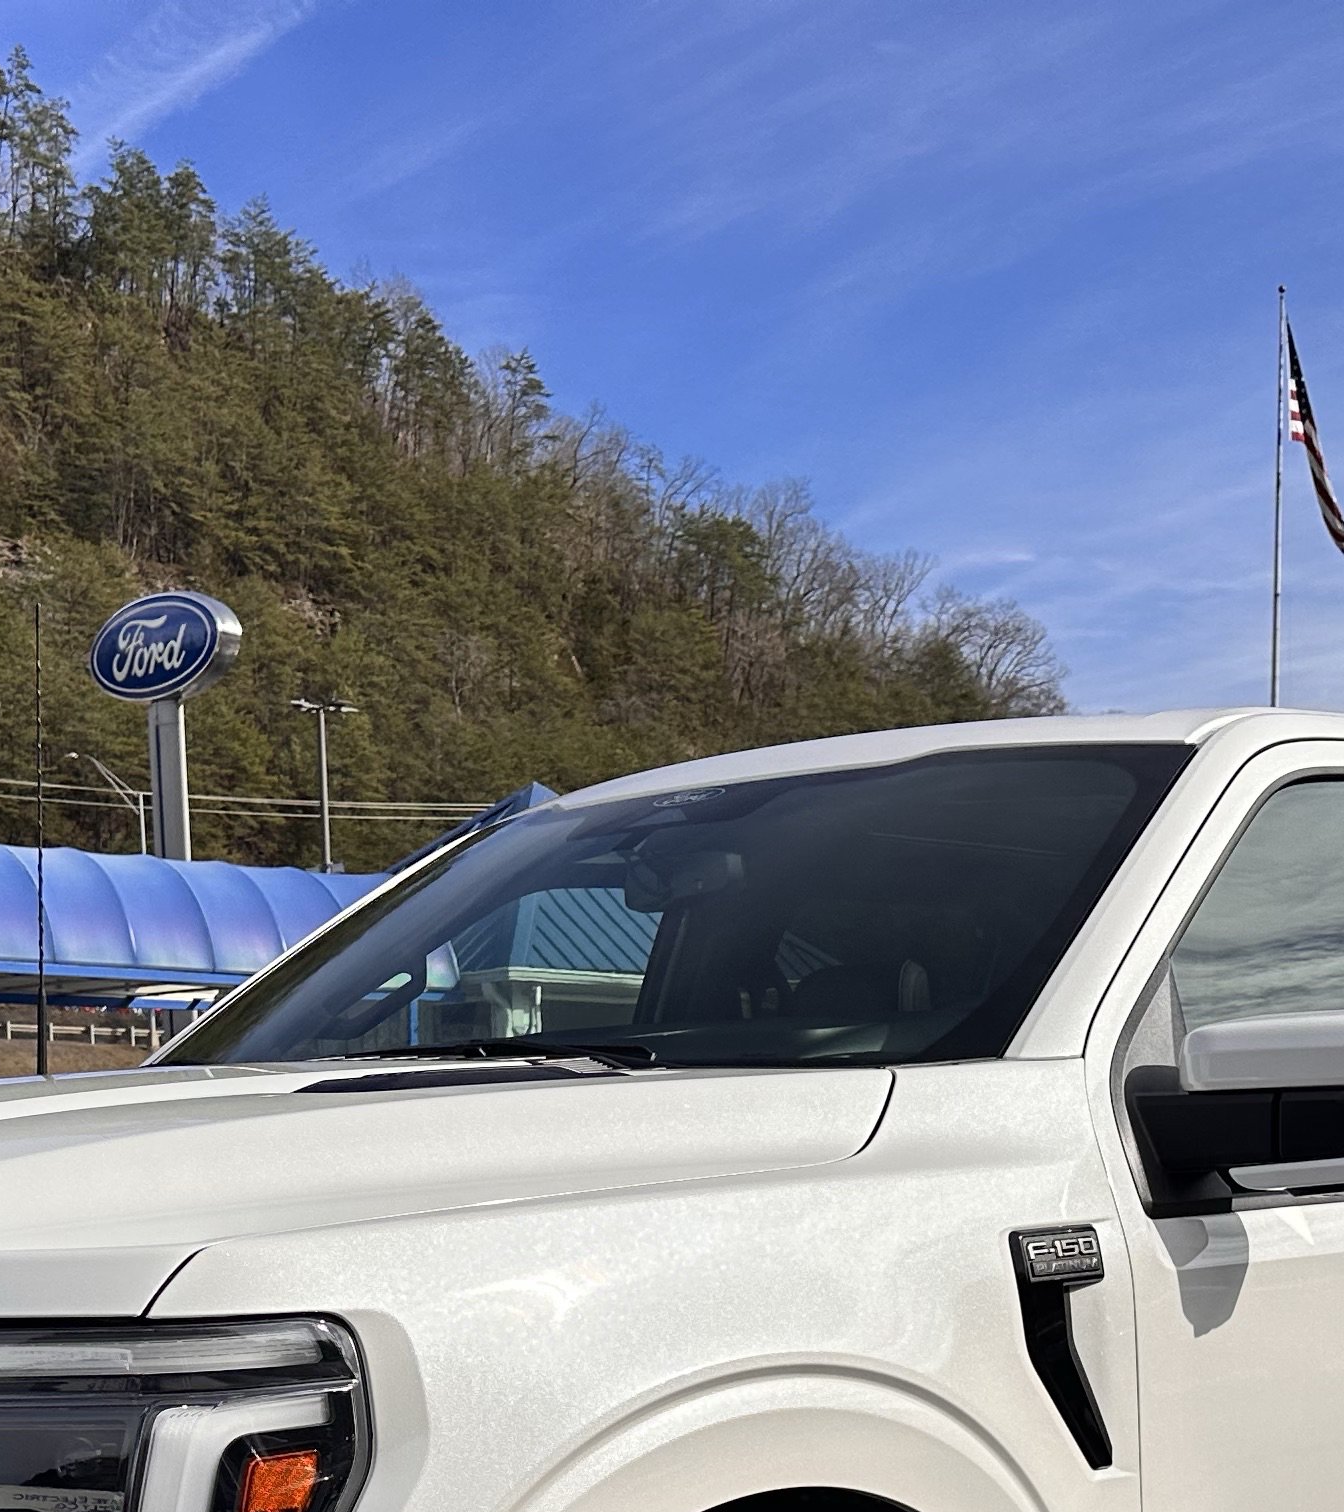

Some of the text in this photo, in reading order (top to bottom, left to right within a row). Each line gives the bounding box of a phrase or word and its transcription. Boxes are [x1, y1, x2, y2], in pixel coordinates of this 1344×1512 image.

[112, 614, 187, 682] Ford
[1027, 1237, 1099, 1260] F-150
[1036, 1256, 1098, 1273] PLATINUM
